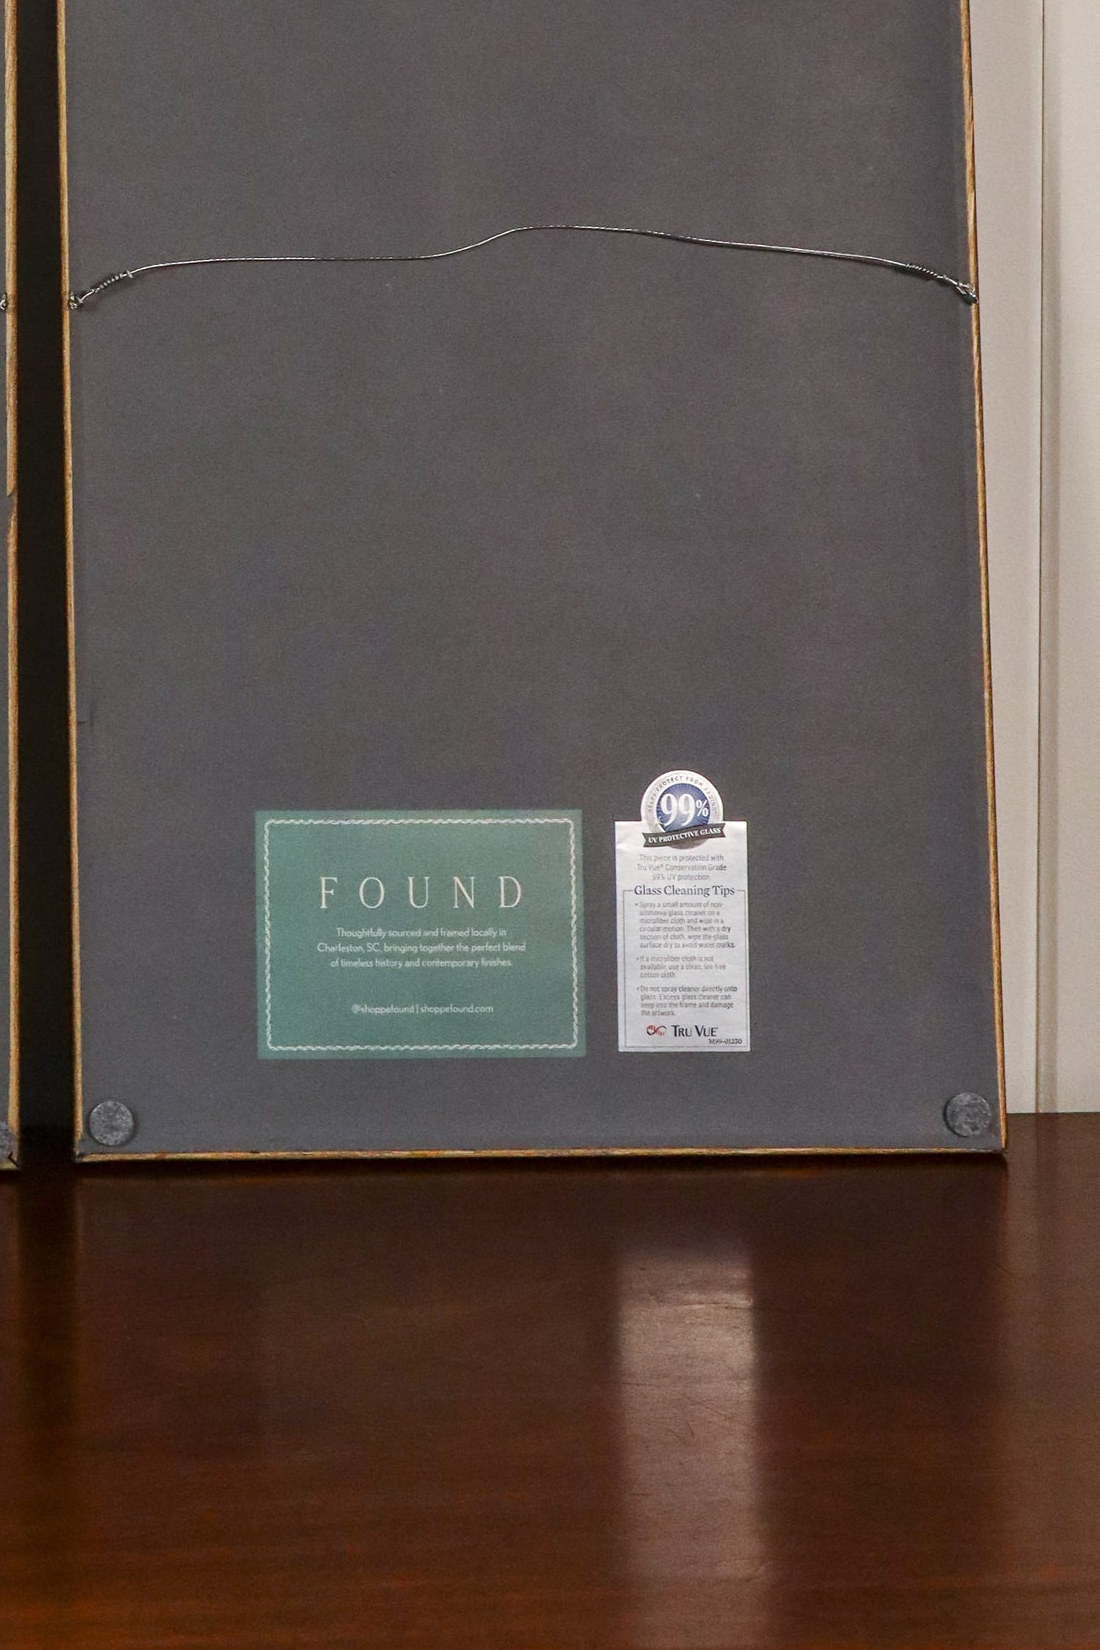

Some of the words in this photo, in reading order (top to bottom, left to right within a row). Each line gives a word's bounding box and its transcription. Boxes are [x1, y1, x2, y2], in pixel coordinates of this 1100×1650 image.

[657, 776, 682, 792] PROTECT
[686, 776, 703, 786] FROM
[661, 793, 708, 826] 99%
[659, 831, 699, 842] PROTECTIVE
[700, 828, 721, 836] GLASS
[320, 876, 521, 909] FOUND
[634, 885, 661, 895] Glass
[664, 885, 710, 897] Cleaning
[712, 886, 735, 897] Tips
[336, 928, 386, 939] Thoughtfully
[389, 928, 421, 937] sourced
[423, 928, 438, 937] and
[440, 927, 469, 937] framed
[471, 928, 497, 938] locally
[384, 943, 417, 954] bringing
[419, 943, 454, 953] together
[456, 942, 469, 952] the
[472, 942, 500, 952] perfect
[503, 942, 525, 952] blend
[331, 958, 339, 968] of
[341, 959, 373, 968] timeless
[375, 958, 402, 968] history
[404, 958, 420, 967] and
[422, 958, 479, 968] contemporary
[352, 1004, 414, 1014] @shoppefound
[421, 1004, 494, 1014] shoppefound.com
[672, 1025, 692, 1037] TRU
[695, 1026, 718, 1037] VUE
